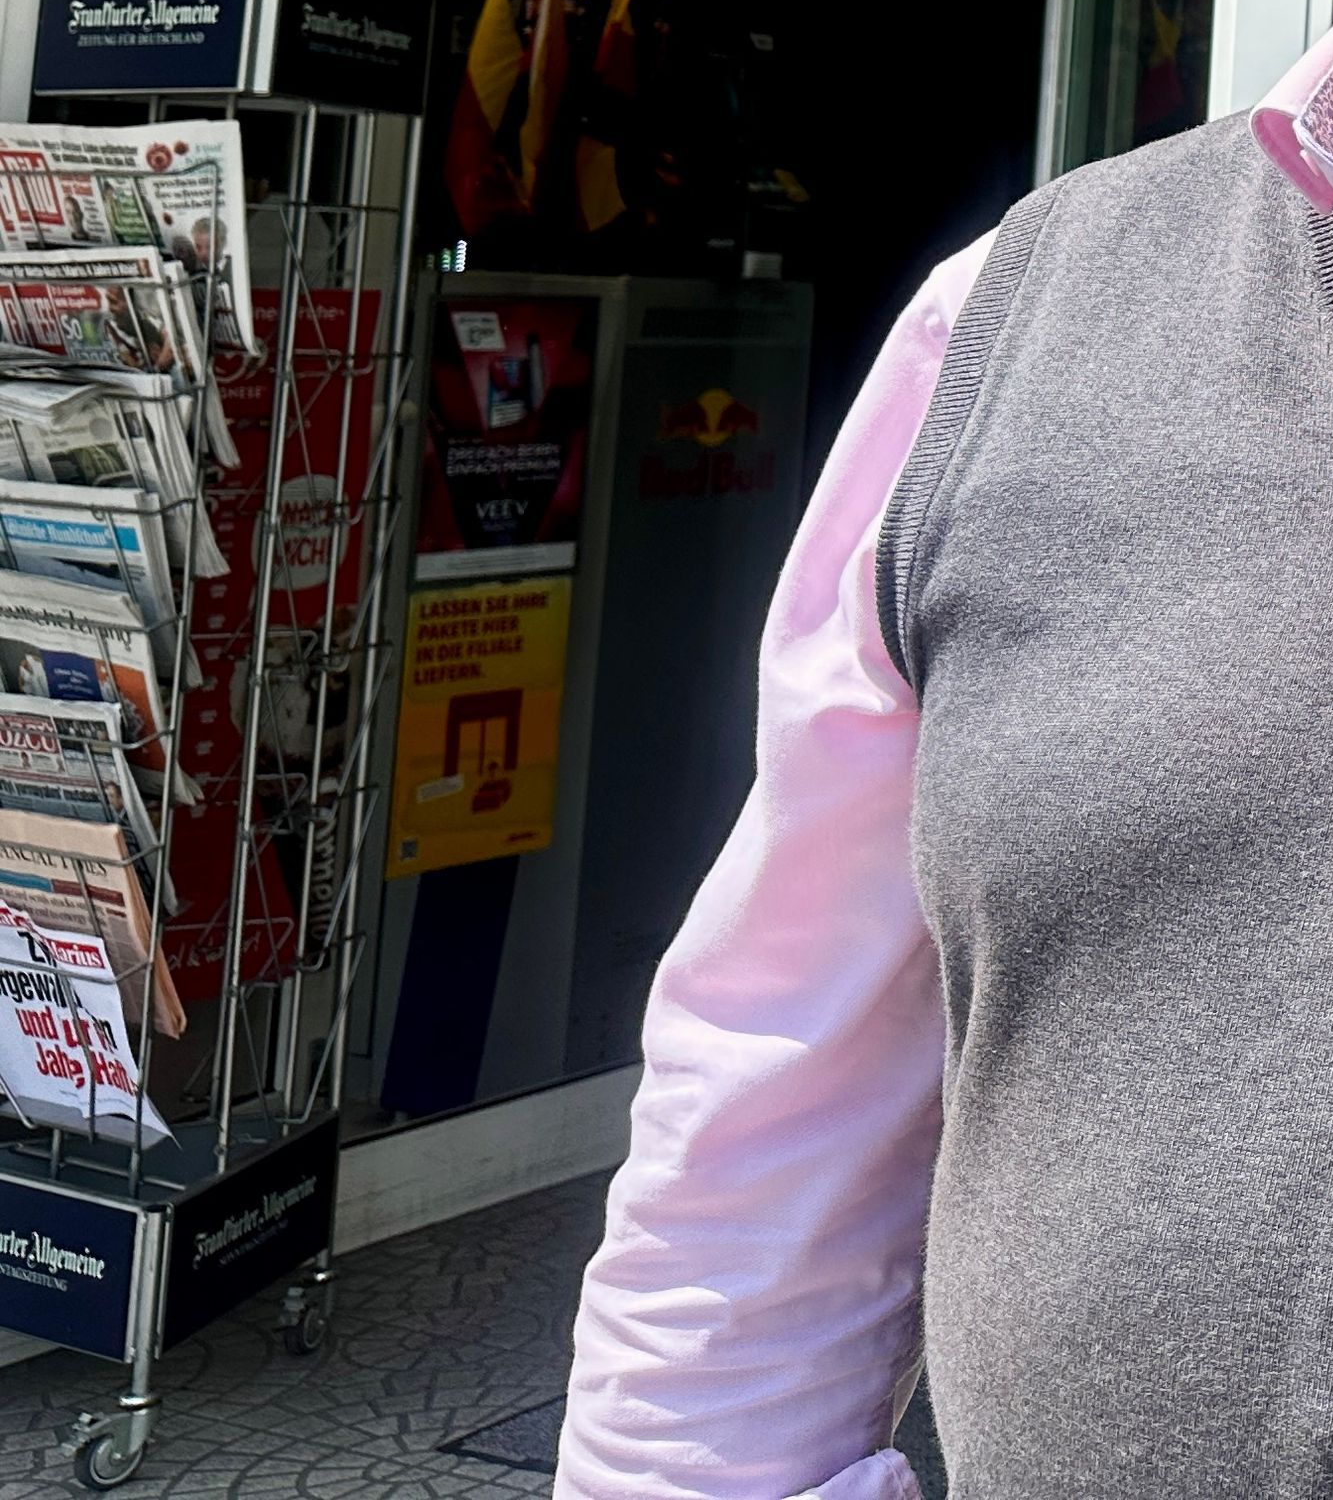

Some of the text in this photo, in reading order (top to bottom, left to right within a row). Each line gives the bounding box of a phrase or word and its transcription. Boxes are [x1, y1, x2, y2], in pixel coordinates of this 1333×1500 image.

[69, 0, 145, 34] Frankfurter
[419, 598, 482, 621] LASSEN
[417, 619, 479, 641] PAKETE
[415, 644, 435, 664] IN
[437, 640, 463, 661] DIE
[25, 1231, 106, 1281] Allgemeine
